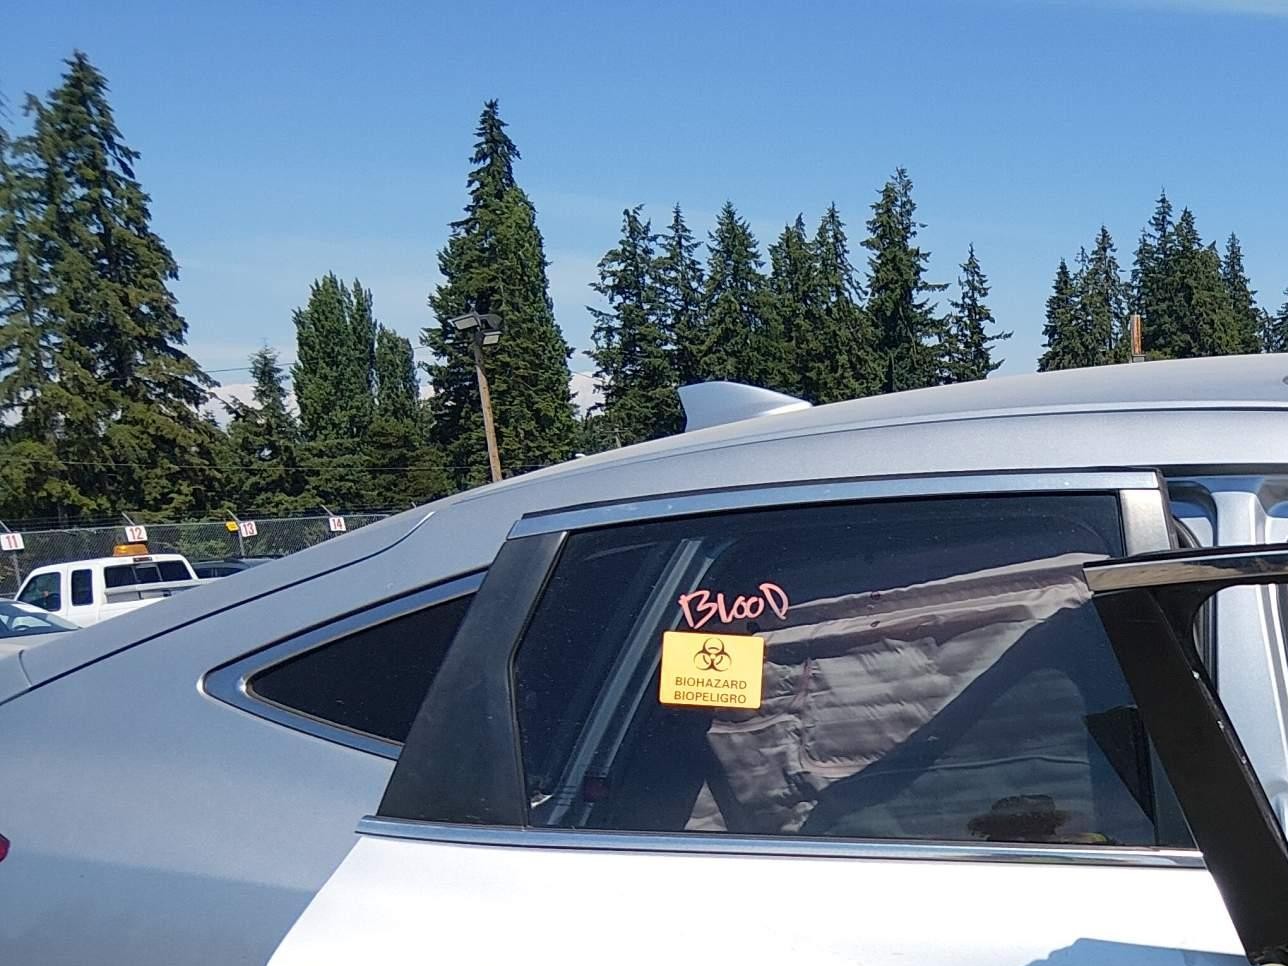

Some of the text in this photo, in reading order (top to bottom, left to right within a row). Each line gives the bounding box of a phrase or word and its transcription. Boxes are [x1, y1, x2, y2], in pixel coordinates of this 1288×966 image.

[243, 523, 255, 536] 13
[332, 518, 343, 530] 14
[130, 527, 144, 540] 12
[5, 536, 19, 549] 11
[675, 676, 748, 690] BIOHAZARD
[674, 690, 747, 704] BIOPELIGRO
